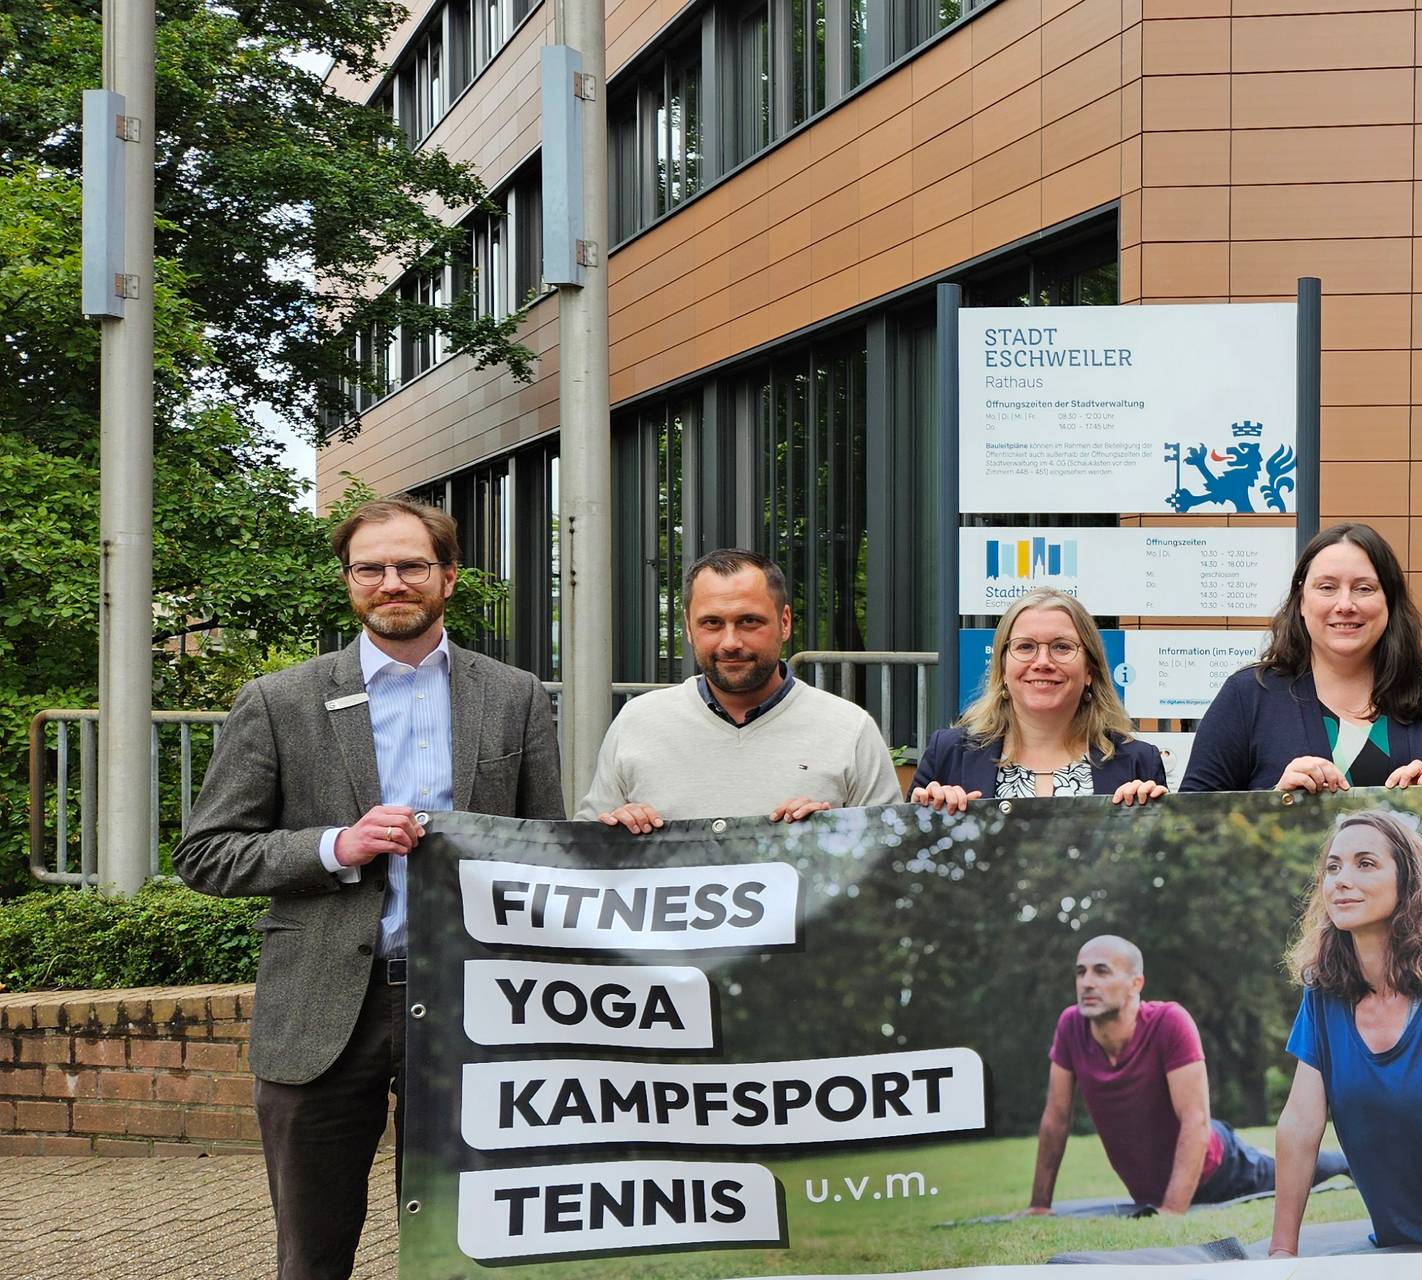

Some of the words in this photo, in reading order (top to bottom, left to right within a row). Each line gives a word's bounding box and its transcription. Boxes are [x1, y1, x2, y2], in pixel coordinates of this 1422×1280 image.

[985, 328, 1058, 347] STADT
[985, 349, 1133, 368] ESCHWEILER
[985, 375, 1044, 389] Rathaus
[1054, 400, 1069, 408] der
[1071, 399, 1145, 410] Stadtverwaltung
[1146, 538, 1207, 547] Öffnungszeiten
[986, 585, 1078, 598] Stadtbei
[1158, 648, 1211, 656] Information
[1212, 647, 1227, 657] (im
[1228, 647, 1257, 657] Foyer)
[492, 879, 767, 932] FITNESS
[495, 977, 686, 1031] YOGA
[498, 1066, 954, 1129] KAMPFSPORT
[805, 1168, 940, 1204] u.v.m.
[494, 1178, 748, 1236] TENNIS
